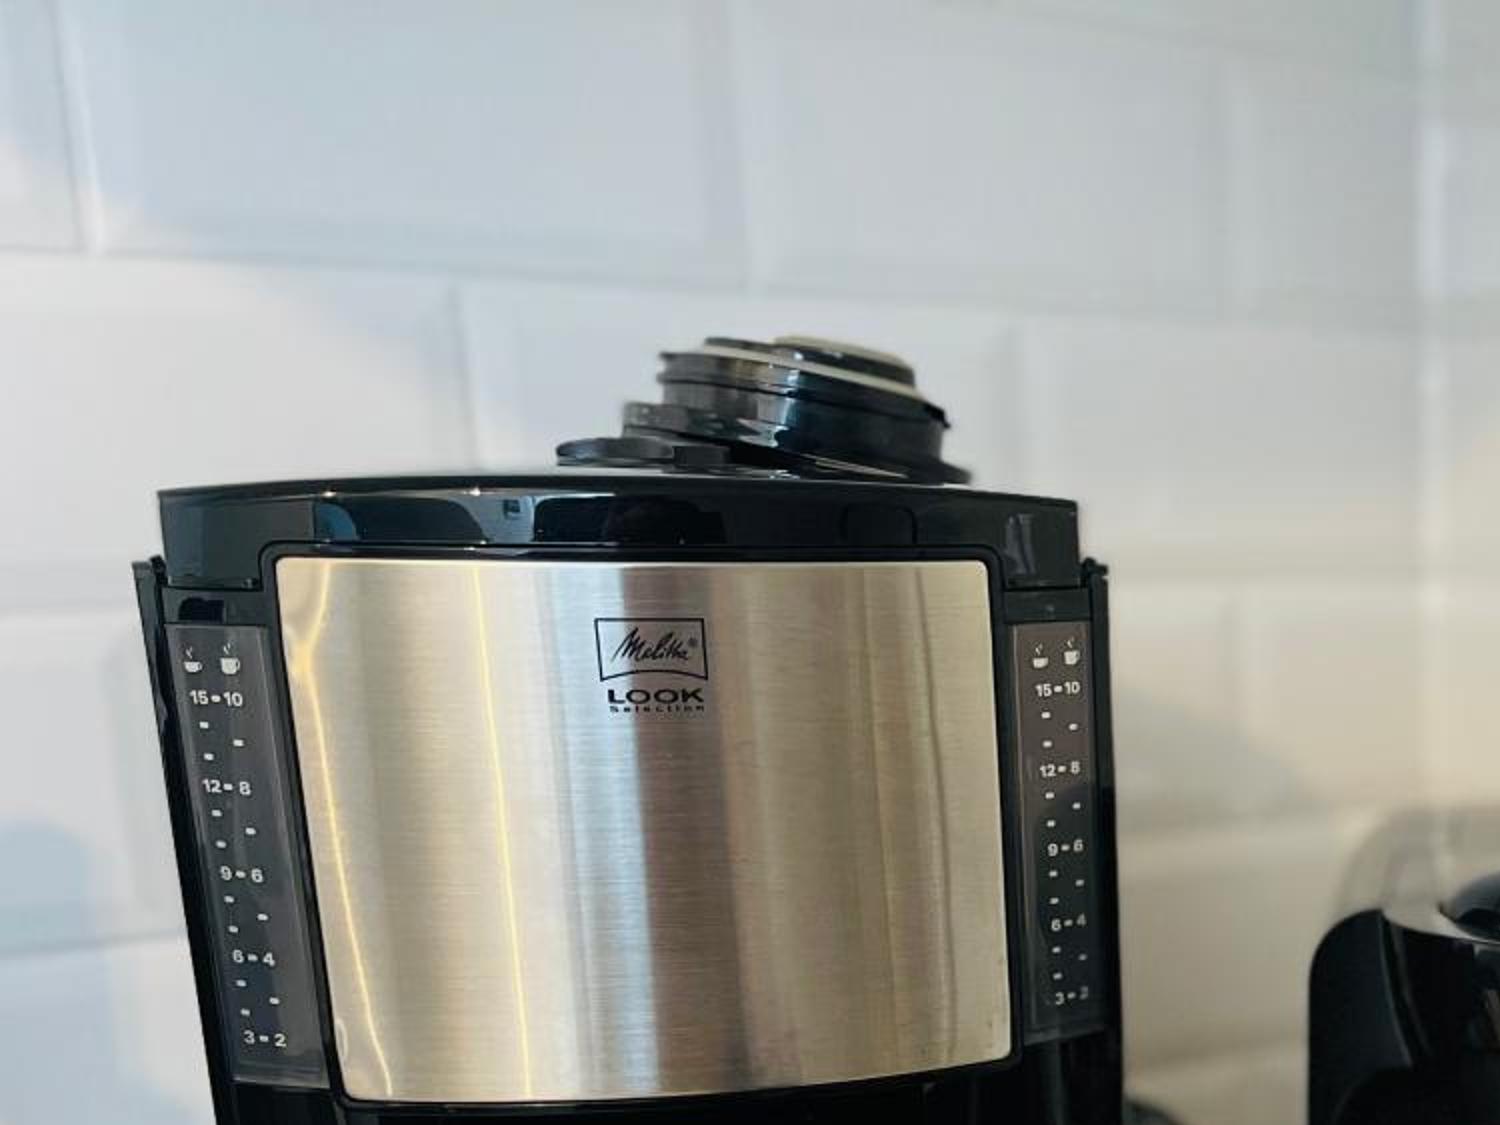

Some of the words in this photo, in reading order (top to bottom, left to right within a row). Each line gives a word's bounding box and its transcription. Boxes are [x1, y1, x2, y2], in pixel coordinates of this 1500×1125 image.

[611, 626, 689, 662] Melitta
[608, 689, 704, 704] LOOK
[239, 781, 251, 796] 8
[1047, 843, 1059, 857] 9
[220, 866, 232, 881] 9
[251, 868, 263, 883] 6
[232, 950, 245, 964] 6
[263, 953, 275, 967] 4
[243, 1031, 255, 1046] 3
[274, 1033, 287, 1048] 2
